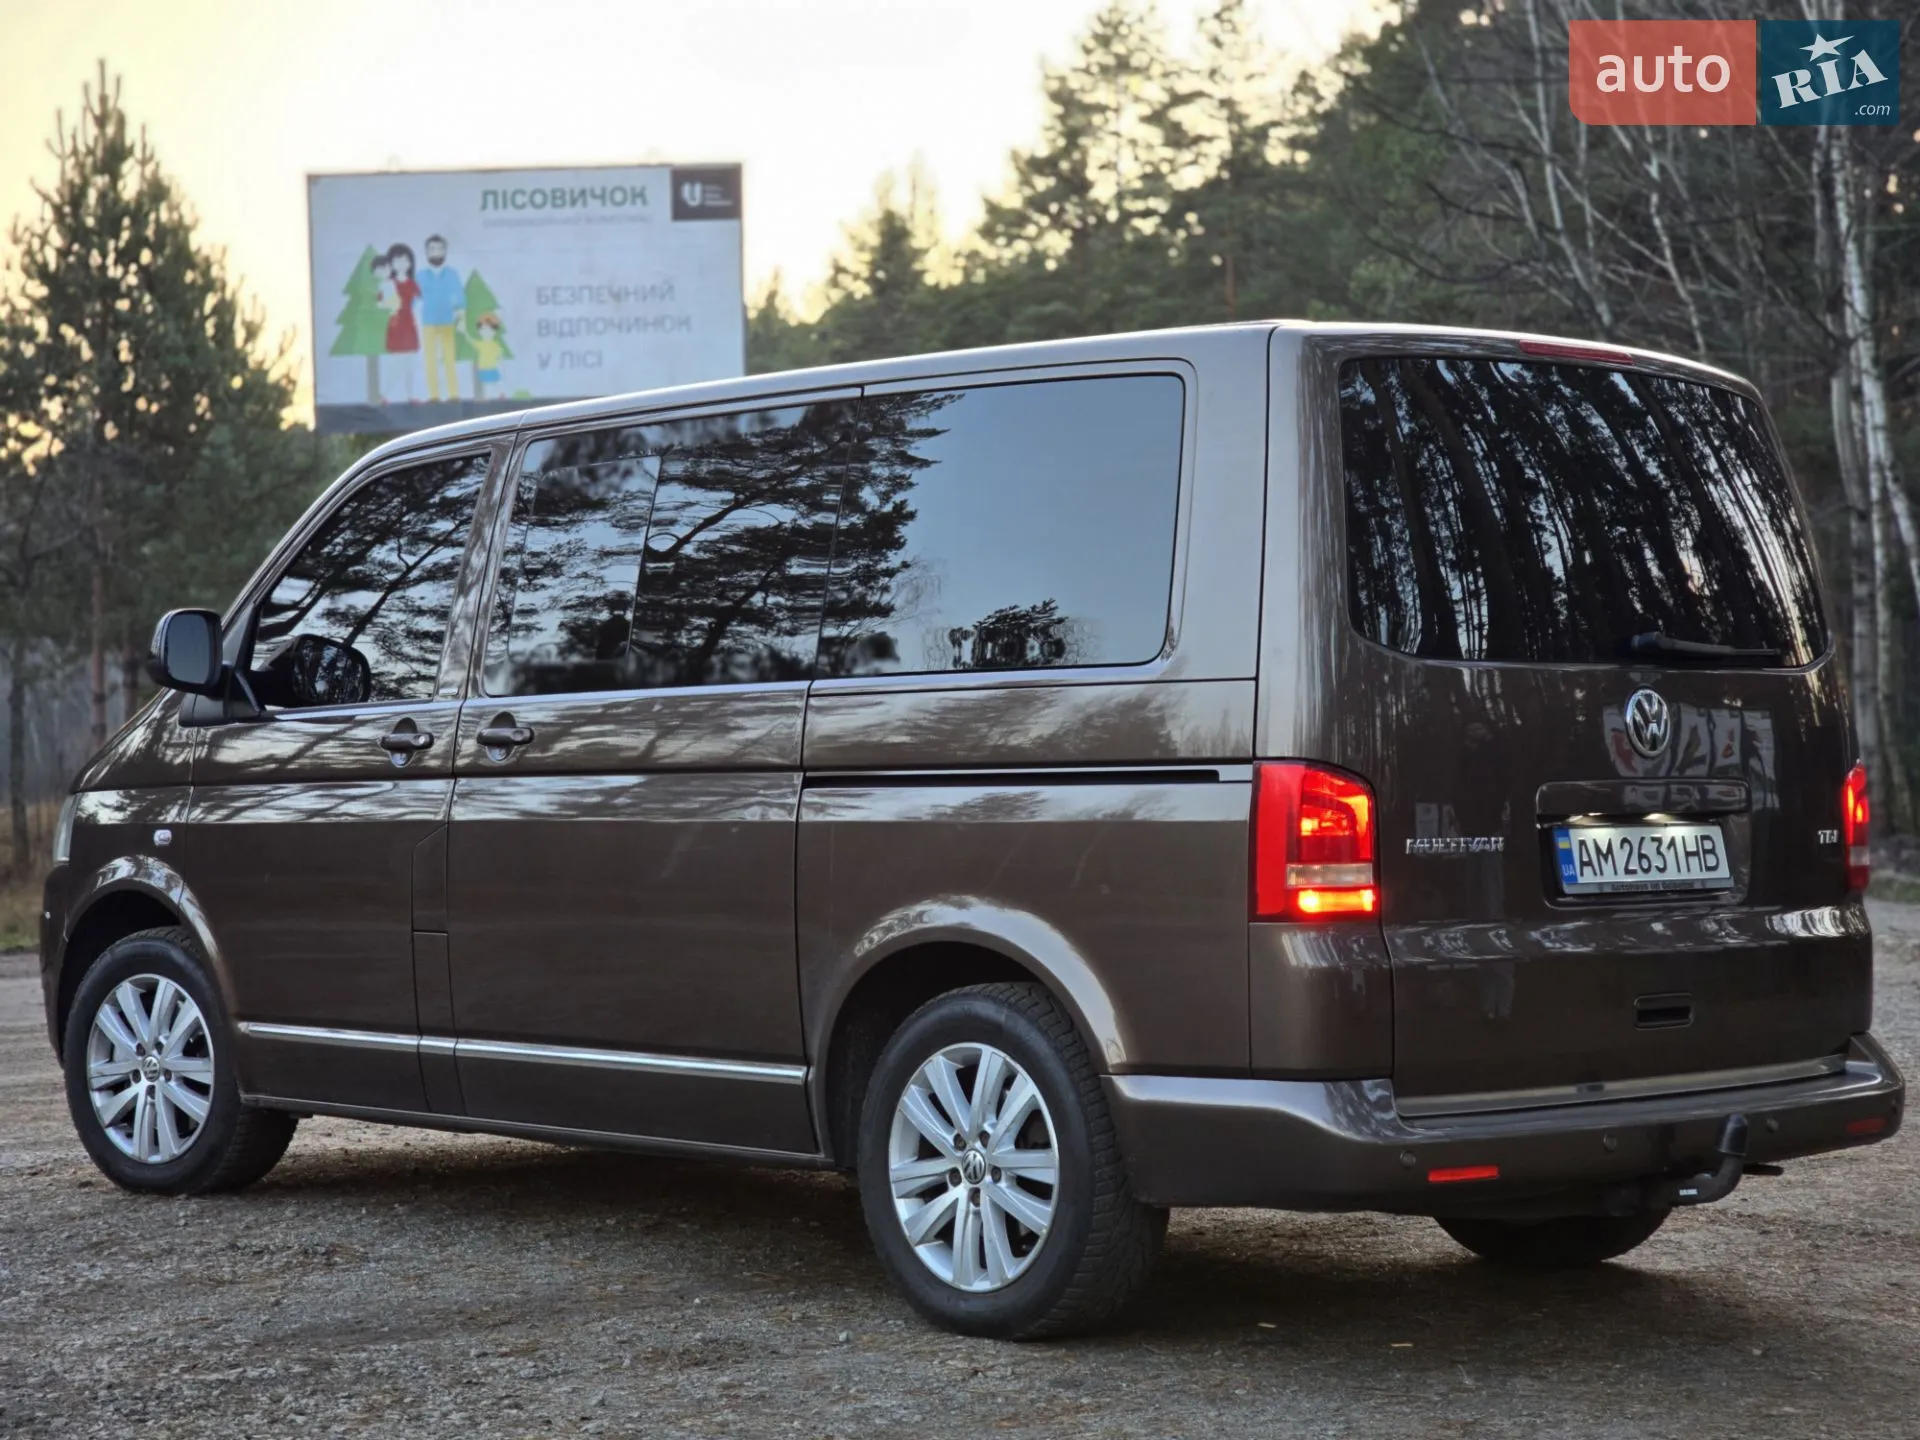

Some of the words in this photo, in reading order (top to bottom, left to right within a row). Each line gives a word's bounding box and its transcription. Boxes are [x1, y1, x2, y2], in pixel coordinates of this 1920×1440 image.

[480, 185, 648, 211] ЛІСОВИЧОК
[536, 282, 676, 306] БЕЗПЕЧНИЙ
[537, 315, 692, 339] ВІДПОЧИНОК
[1562, 865, 1576, 876] UA
